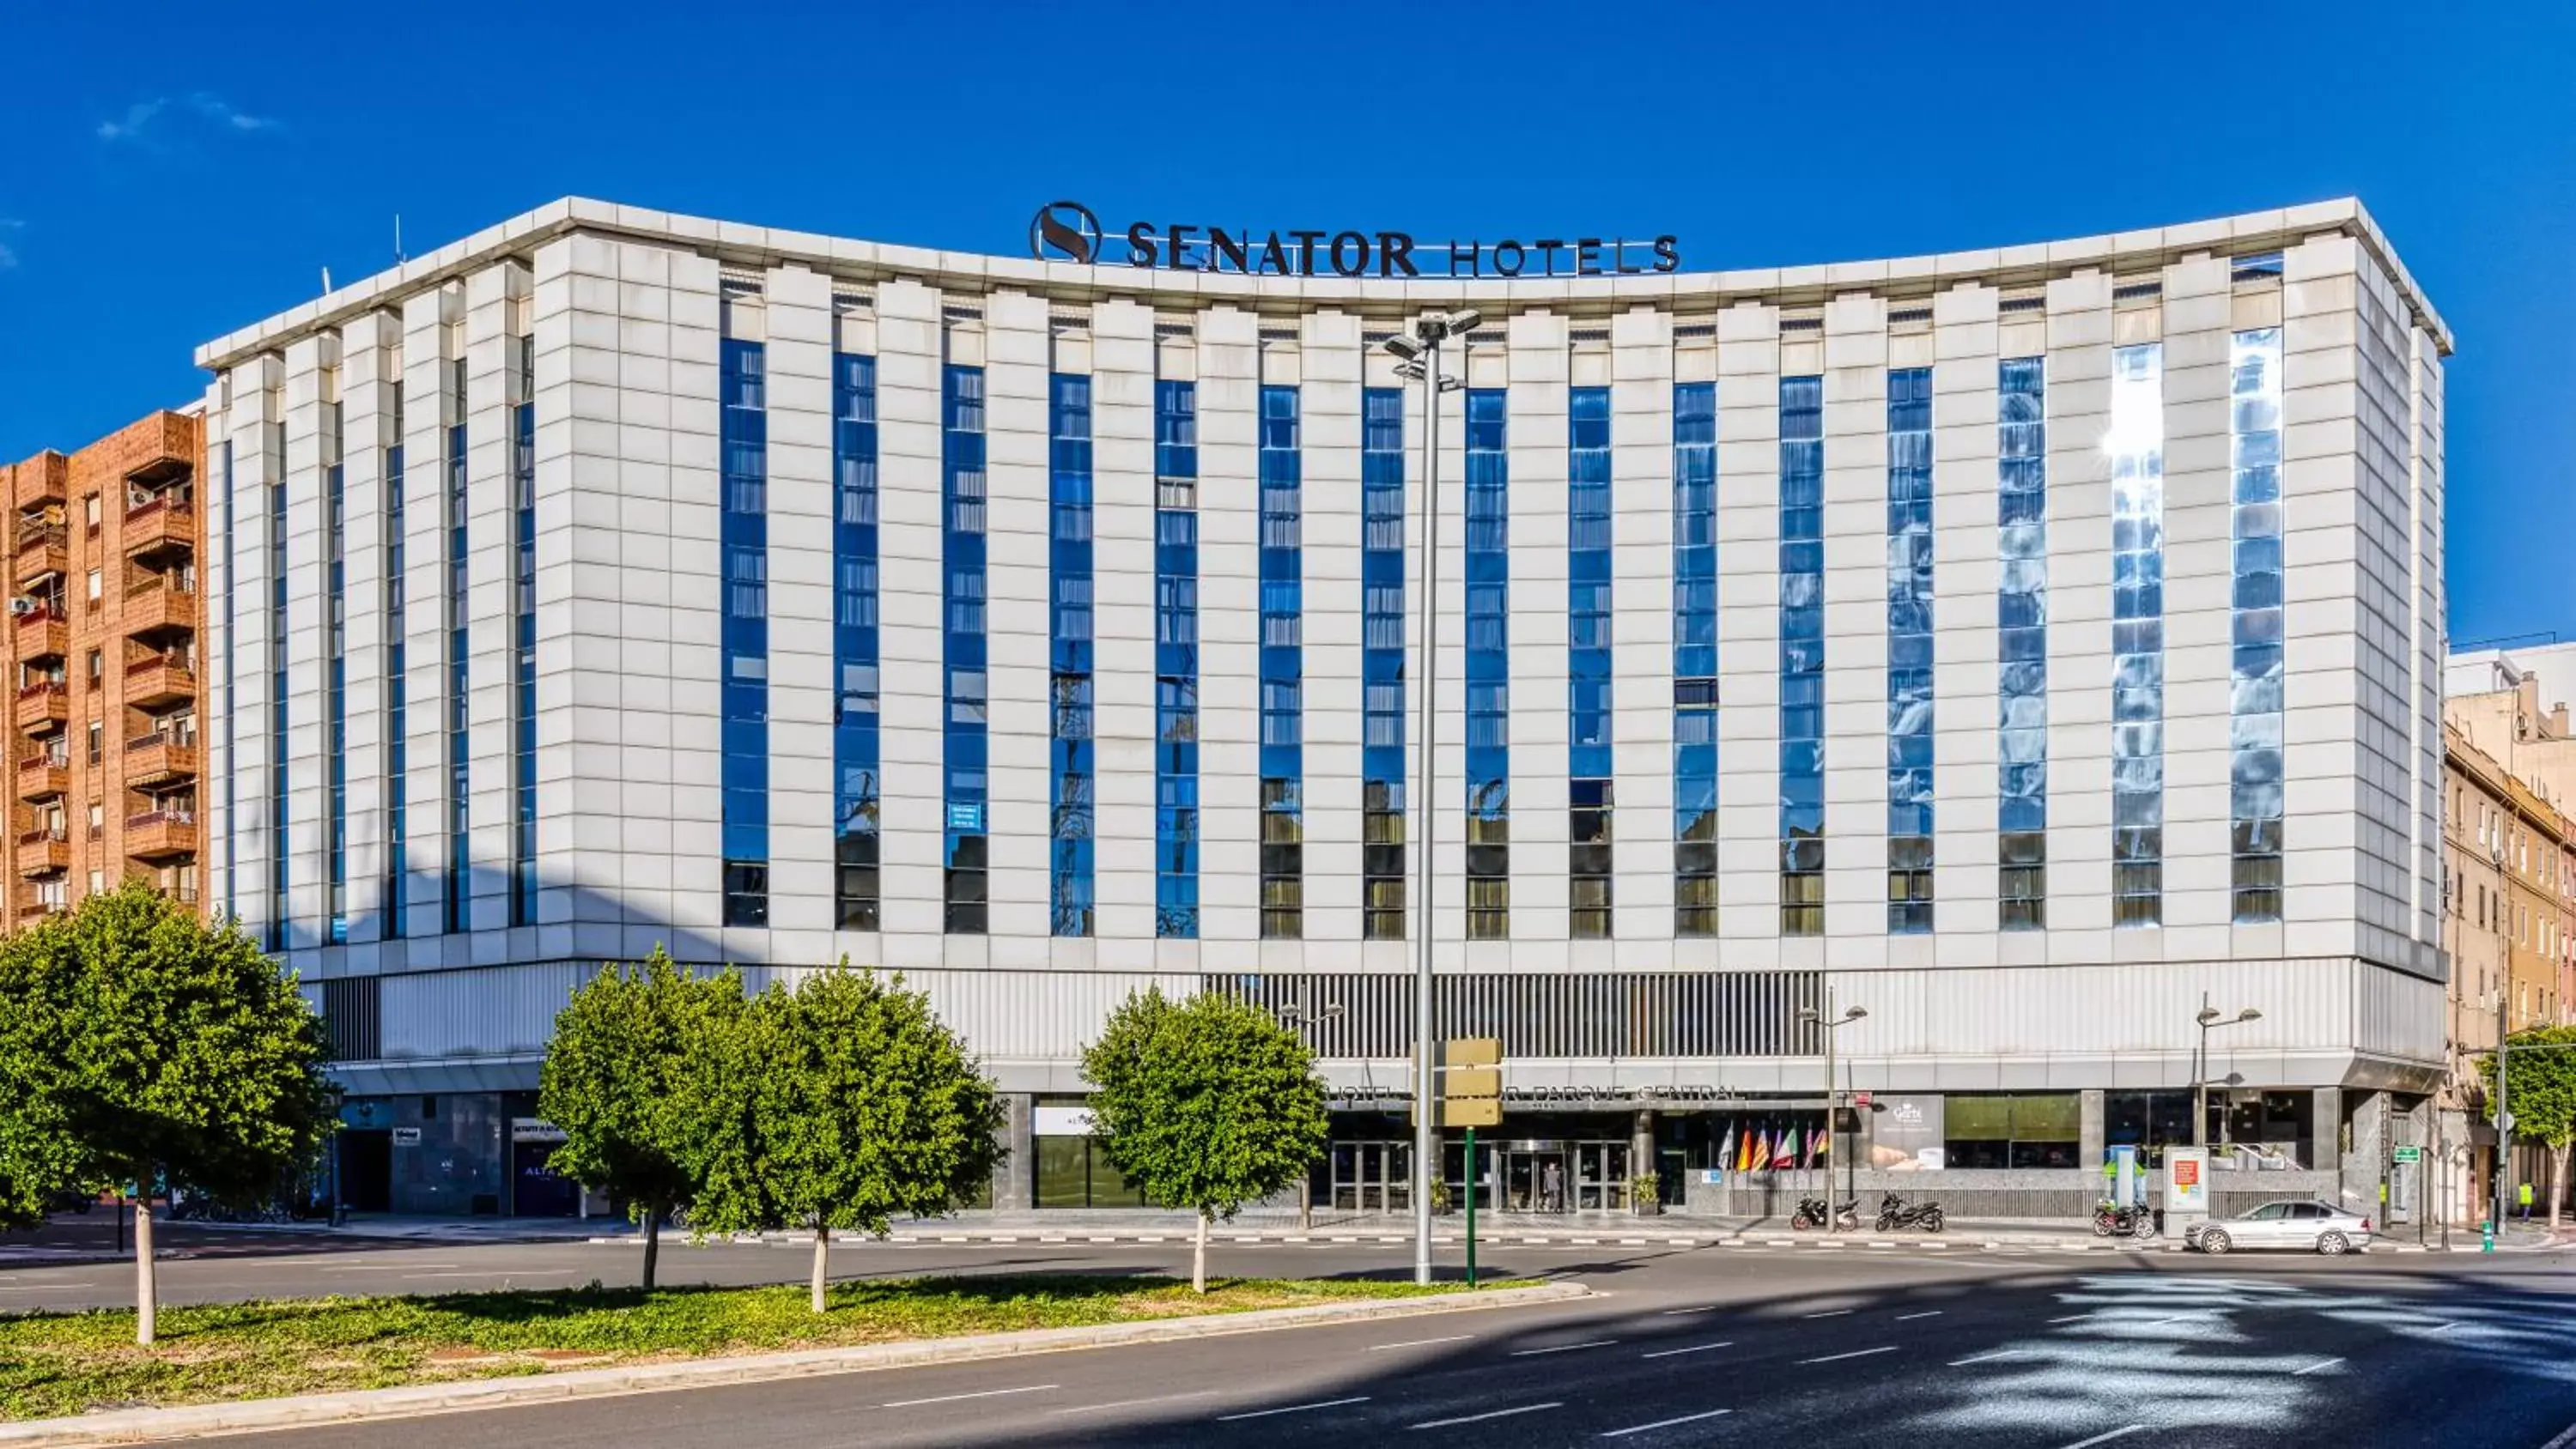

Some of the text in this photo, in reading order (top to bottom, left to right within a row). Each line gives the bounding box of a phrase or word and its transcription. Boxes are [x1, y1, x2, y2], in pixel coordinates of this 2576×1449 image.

[1127, 221, 1680, 277] SENATOR HOTELS
[1327, 1086, 1401, 1101] HOTEL
[1533, 1086, 1625, 1101] PARQUE
[1637, 1085, 1746, 1101] CENTRAL
